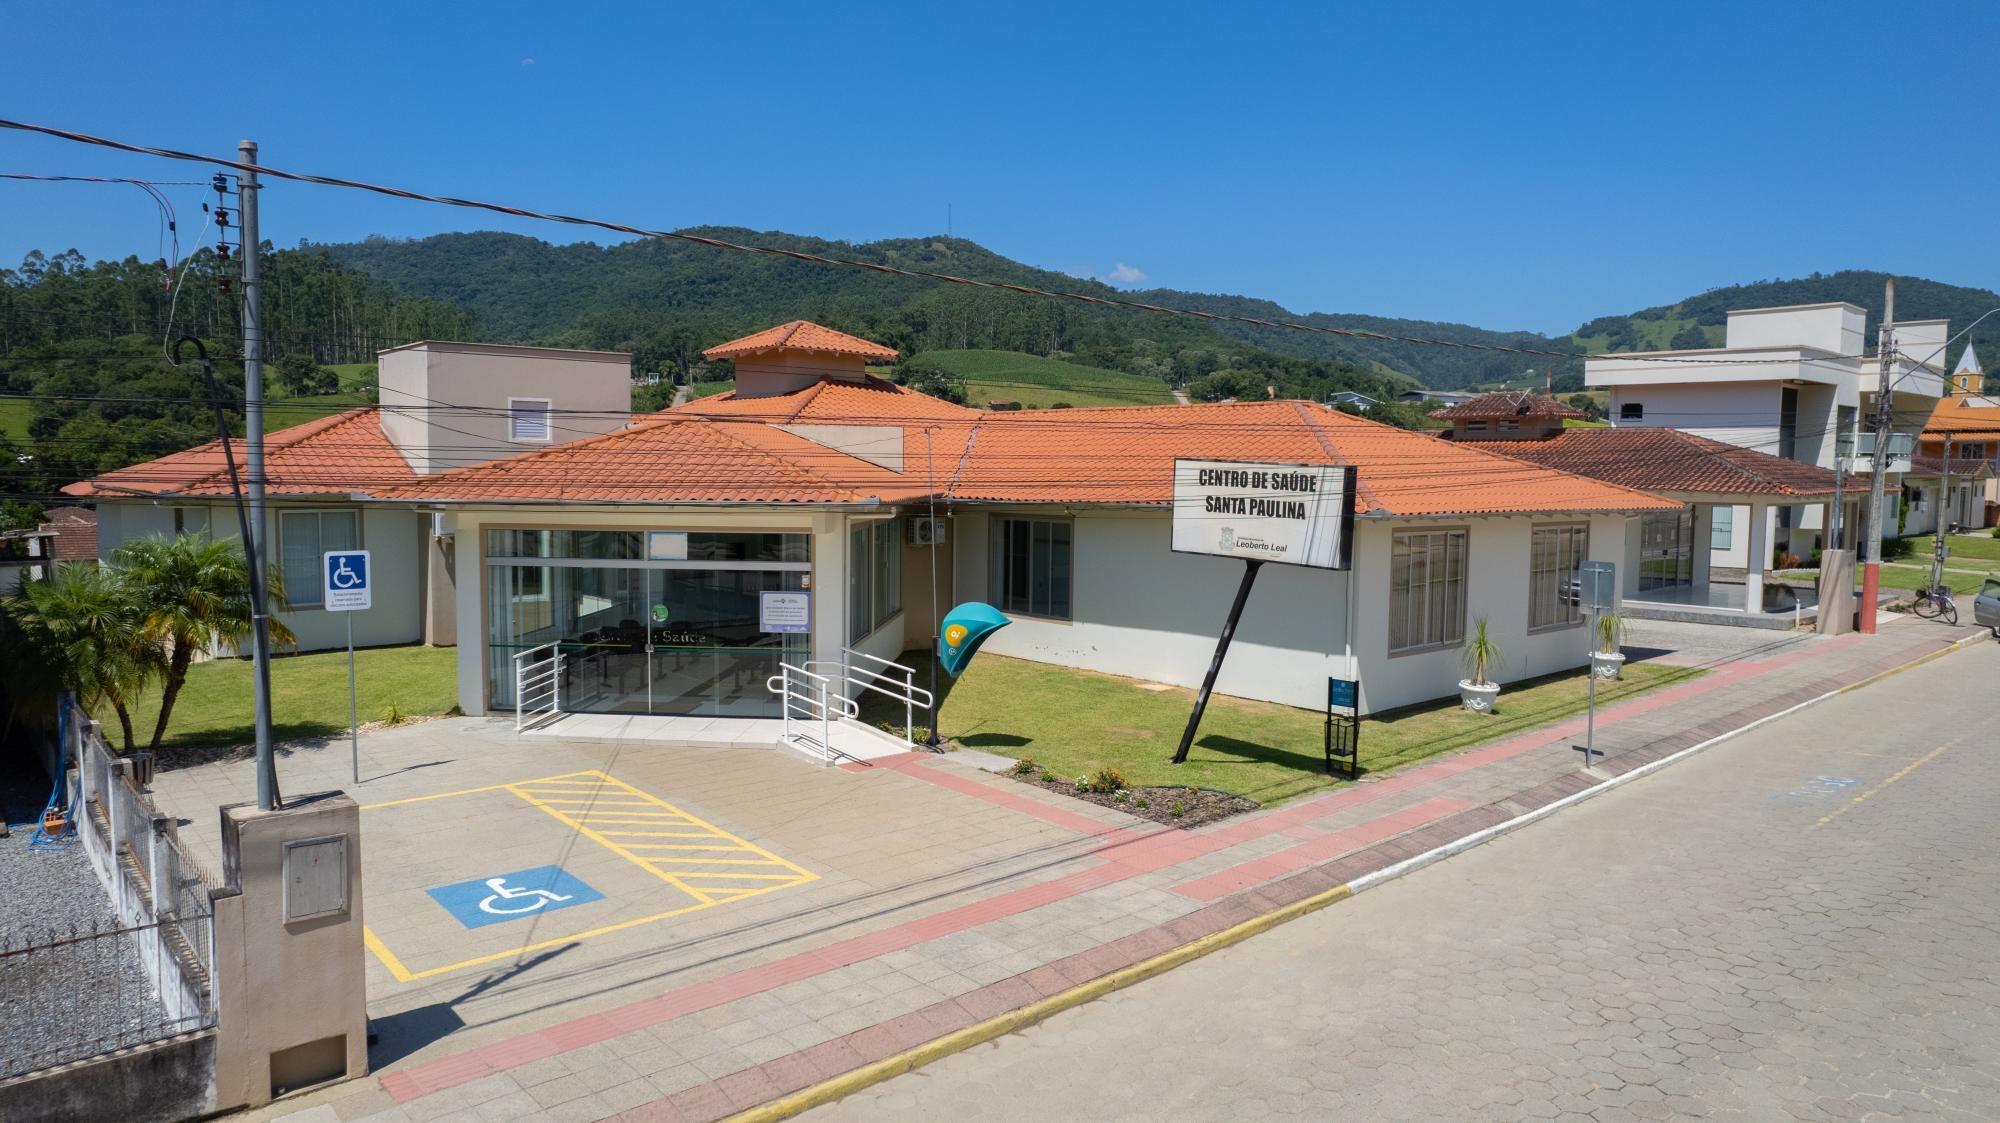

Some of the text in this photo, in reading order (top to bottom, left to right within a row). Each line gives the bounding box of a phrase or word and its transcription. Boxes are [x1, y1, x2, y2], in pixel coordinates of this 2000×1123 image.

[1199, 469, 1317, 492] CENTRO DE SAÚDE
[1205, 495, 1306, 520] SANTA PAULINA
[1236, 540, 1288, 553] Leoberto Leal
